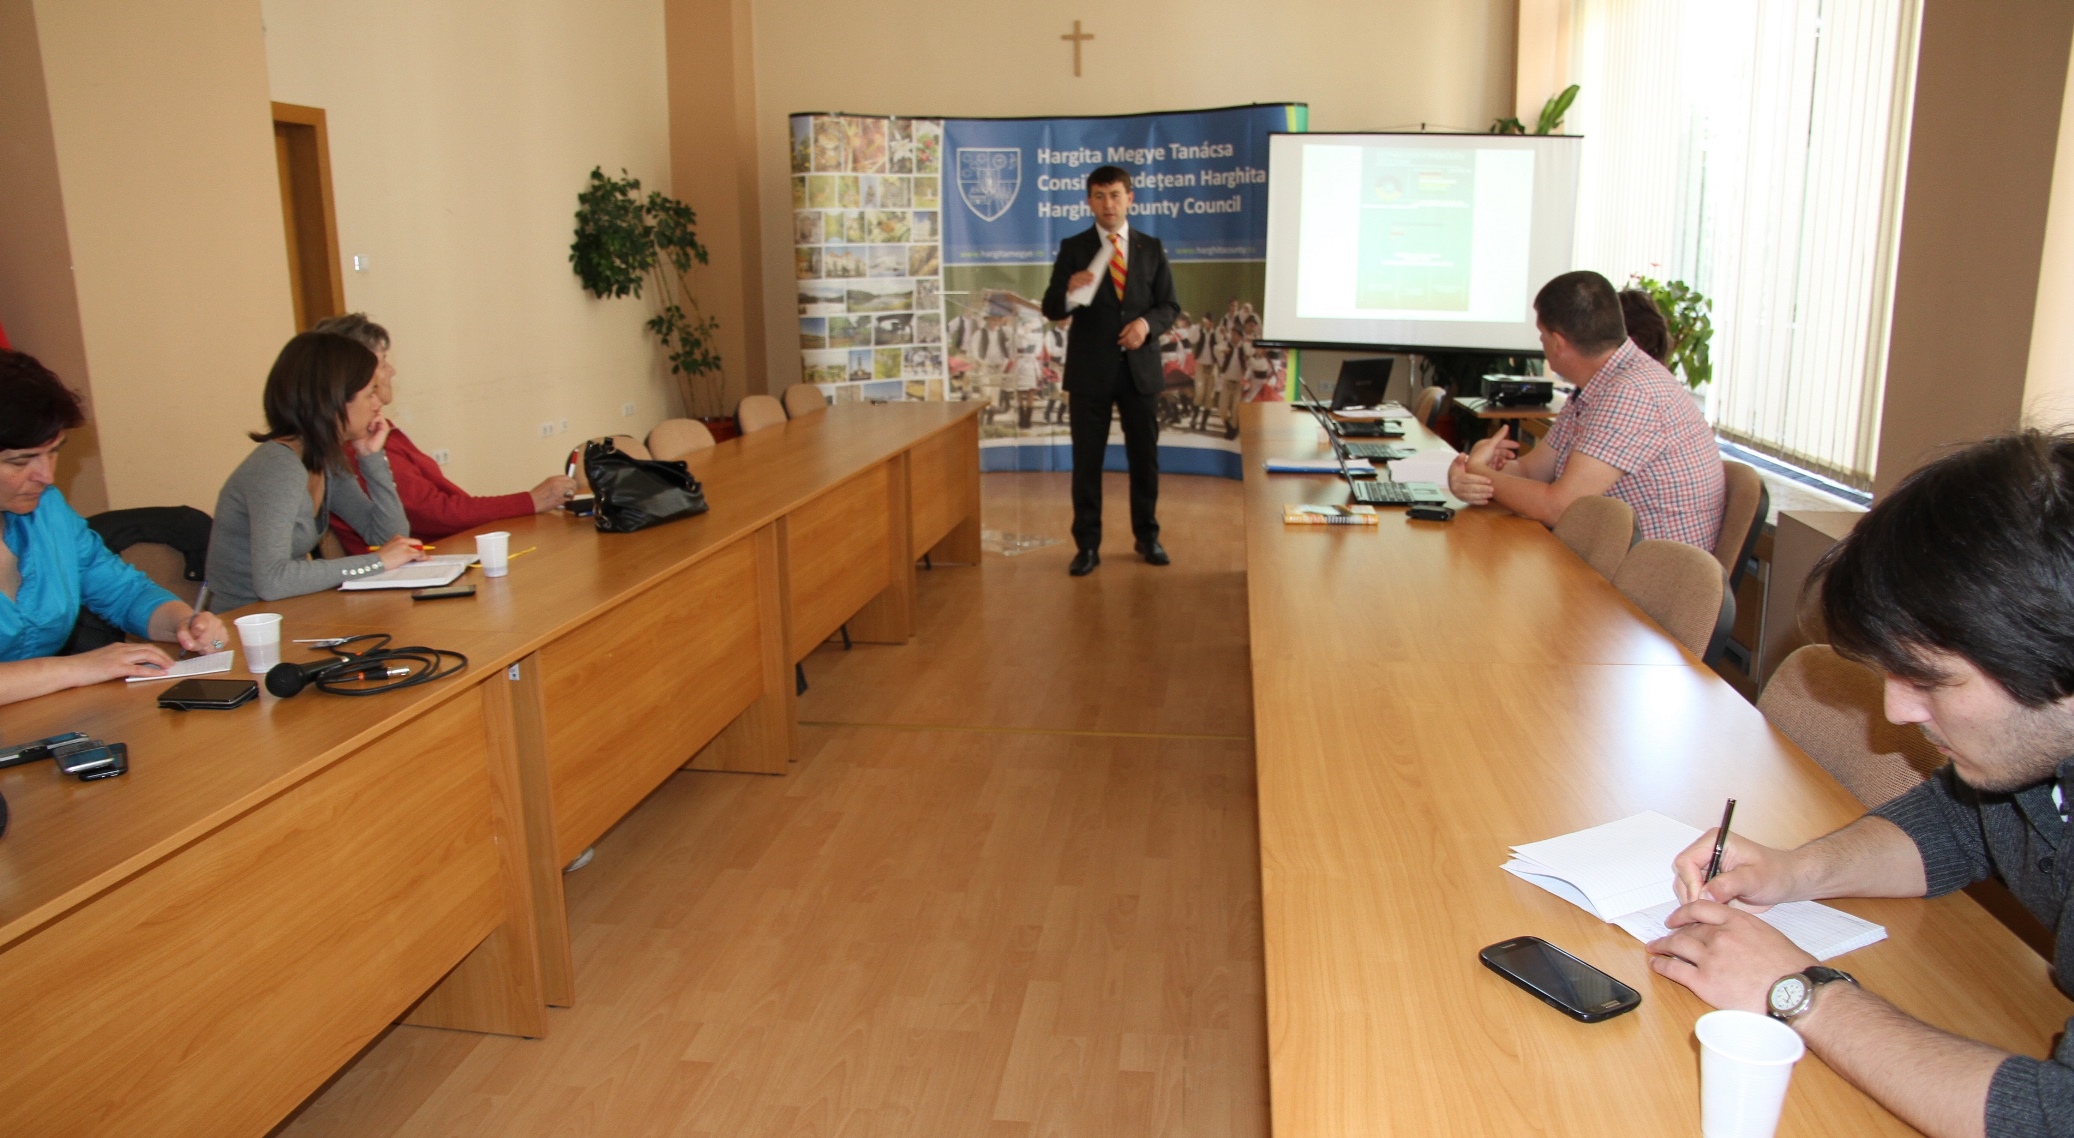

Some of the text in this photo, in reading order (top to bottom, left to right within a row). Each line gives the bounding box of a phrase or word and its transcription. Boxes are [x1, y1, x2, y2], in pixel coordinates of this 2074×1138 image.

[1037, 140, 1234, 168] Hargita Megye Tanácsa
[1037, 166, 1267, 192] Consi dețean Harghita
[1038, 195, 1242, 221] Hargh ounty Council
